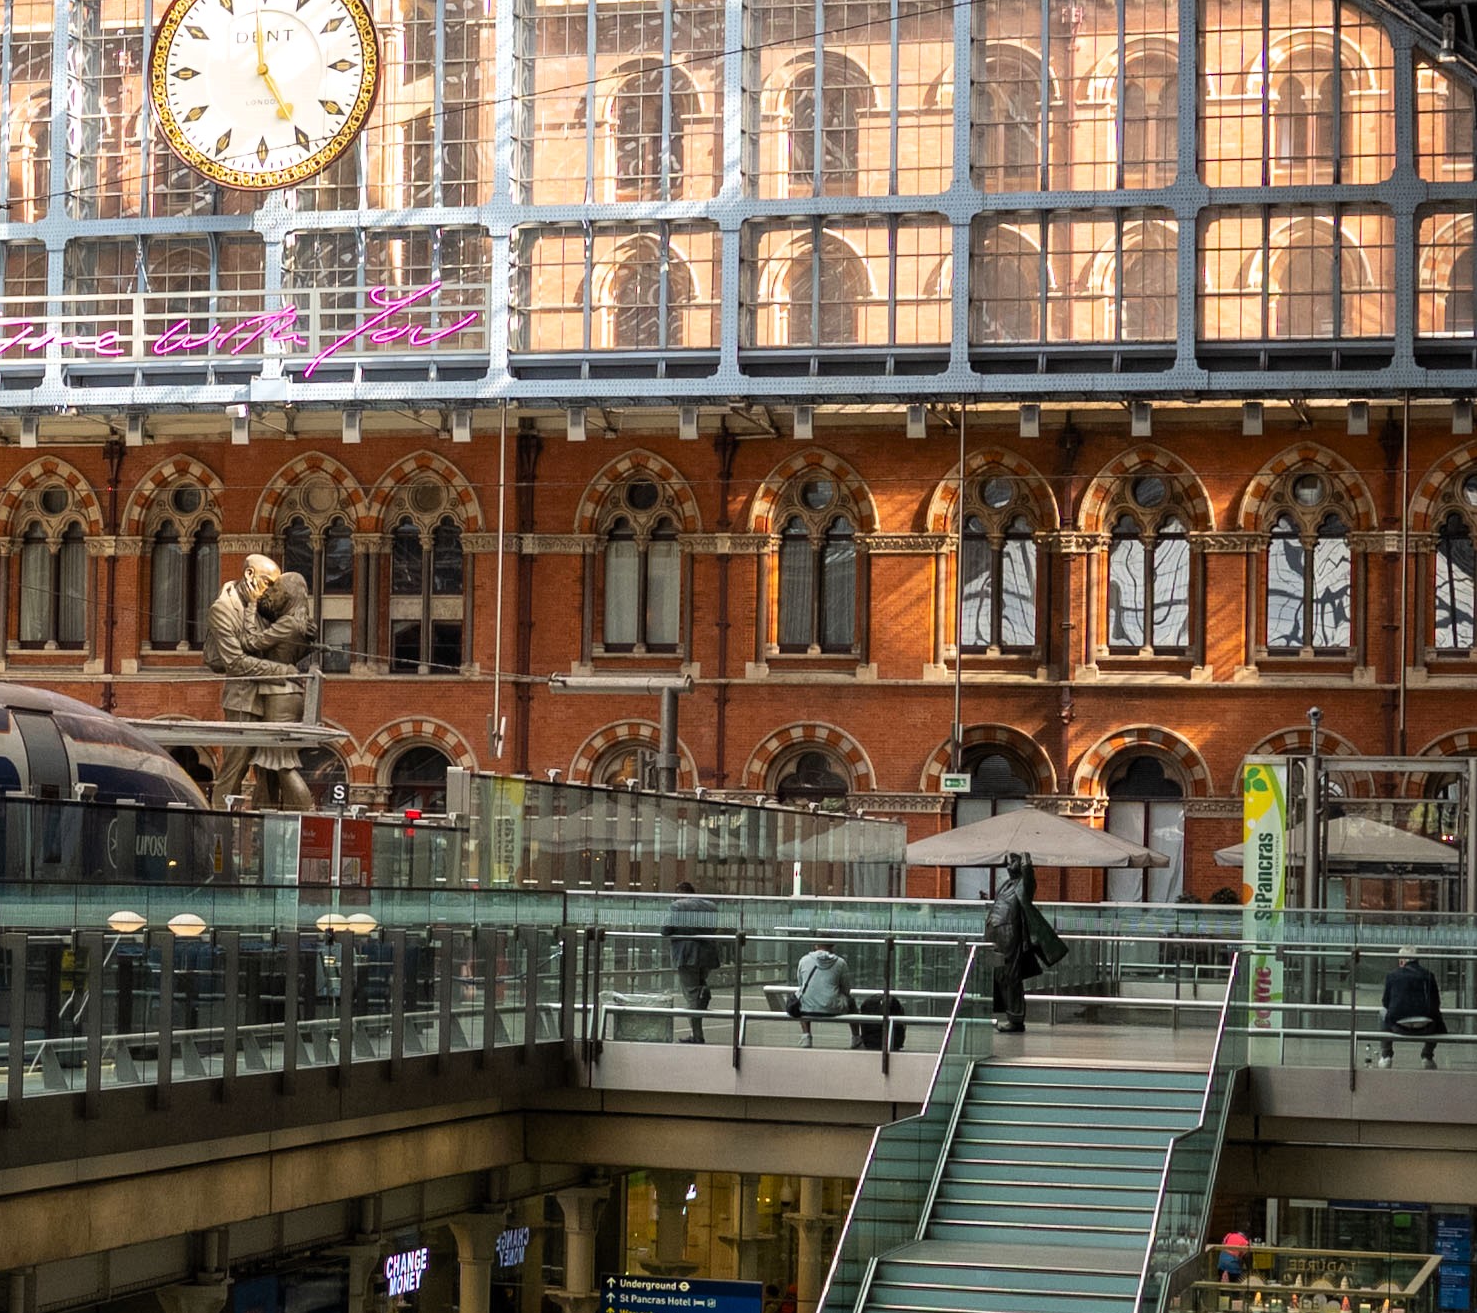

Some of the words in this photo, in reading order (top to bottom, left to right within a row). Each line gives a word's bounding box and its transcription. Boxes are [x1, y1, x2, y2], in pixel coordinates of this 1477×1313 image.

[245, 96, 280, 107] LONDO
[333, 784, 345, 800] S
[385, 1247, 429, 1280] CHANGE
[388, 1269, 423, 1297] MONEY
[619, 1278, 677, 1292] Underground
[619, 1293, 630, 1304] St
[631, 1294, 666, 1306] Pancras
[667, 1297, 692, 1307] Hotel
